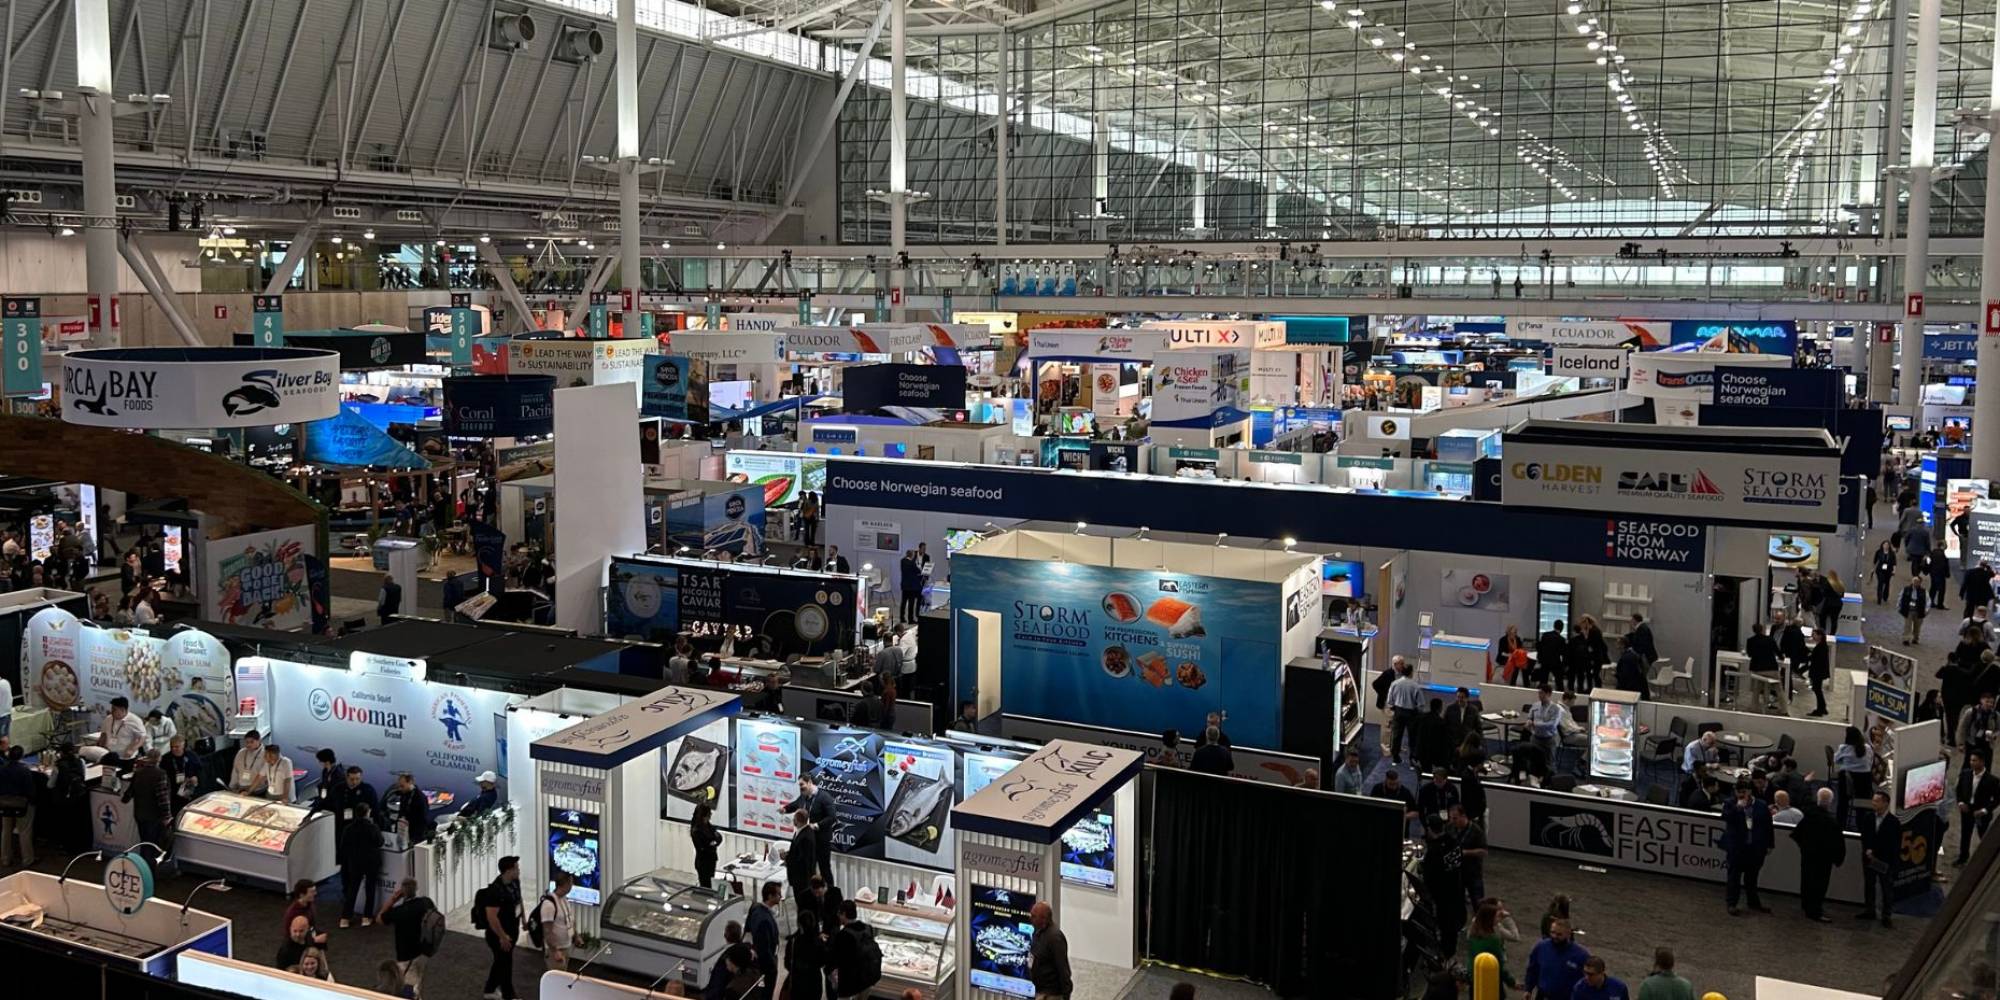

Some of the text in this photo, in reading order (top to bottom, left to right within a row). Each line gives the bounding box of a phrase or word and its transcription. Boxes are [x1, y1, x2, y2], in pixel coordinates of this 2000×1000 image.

[736, 319, 777, 331] HANDY
[788, 334, 841, 347] CUADOR
[1170, 329, 1211, 344] ULTI
[1551, 327, 1616, 340] ECUADOR
[16, 323, 30, 372] 300
[1941, 340, 1965, 351] JBT
[534, 350, 593, 360] LEAD THE WAY
[1558, 354, 1620, 370] Iceland
[527, 360, 593, 372] SUSTAINABILITY
[1174, 366, 1208, 377] Chicken
[110, 369, 157, 398] BAY
[898, 372, 928, 382] Choose
[1721, 373, 1767, 386] Choose
[898, 381, 940, 392] Norwegian
[898, 389, 930, 398] seafood
[1720, 384, 1786, 398] Norwegian
[124, 400, 154, 411] FOODS
[1720, 393, 1769, 406] seafood
[459, 407, 494, 420] Coral
[1511, 461, 1602, 484] GOLDEN
[832, 476, 1003, 500] Choose Norwegian seafood
[1541, 482, 1602, 496] HARVEST
[1742, 483, 1827, 500] SEAFOOD
[1686, 494, 1725, 502] SEAFOOD
[1618, 520, 1700, 538] SEAFOOD
[1617, 534, 1665, 548] FROM
[1616, 546, 1691, 563] NORWAY
[240, 562, 284, 583] GOOD
[681, 574, 721, 590] TSAR
[681, 595, 721, 609] CAVIAR
[1013, 619, 1090, 640] SEAFOOD
[1104, 631, 1160, 646] KITCHENS
[1166, 648, 1201, 661] SUSHI
[90, 676, 123, 690] QUALITY
[1868, 689, 1907, 714] DIM SUM
[333, 696, 408, 730] Oromar
[384, 729, 402, 740] Brand
[426, 750, 481, 765] CALIFORNIA
[429, 758, 477, 772] CALAMARI
[814, 757, 867, 773] agromeyfish
[543, 776, 601, 796] agromeyfish
[816, 770, 868, 788] Fresh and
[1619, 813, 1725, 849] EASTER
[1618, 838, 1680, 868] FISH
[963, 850, 1041, 874] agromeyfish
[108, 869, 141, 895] CFE
